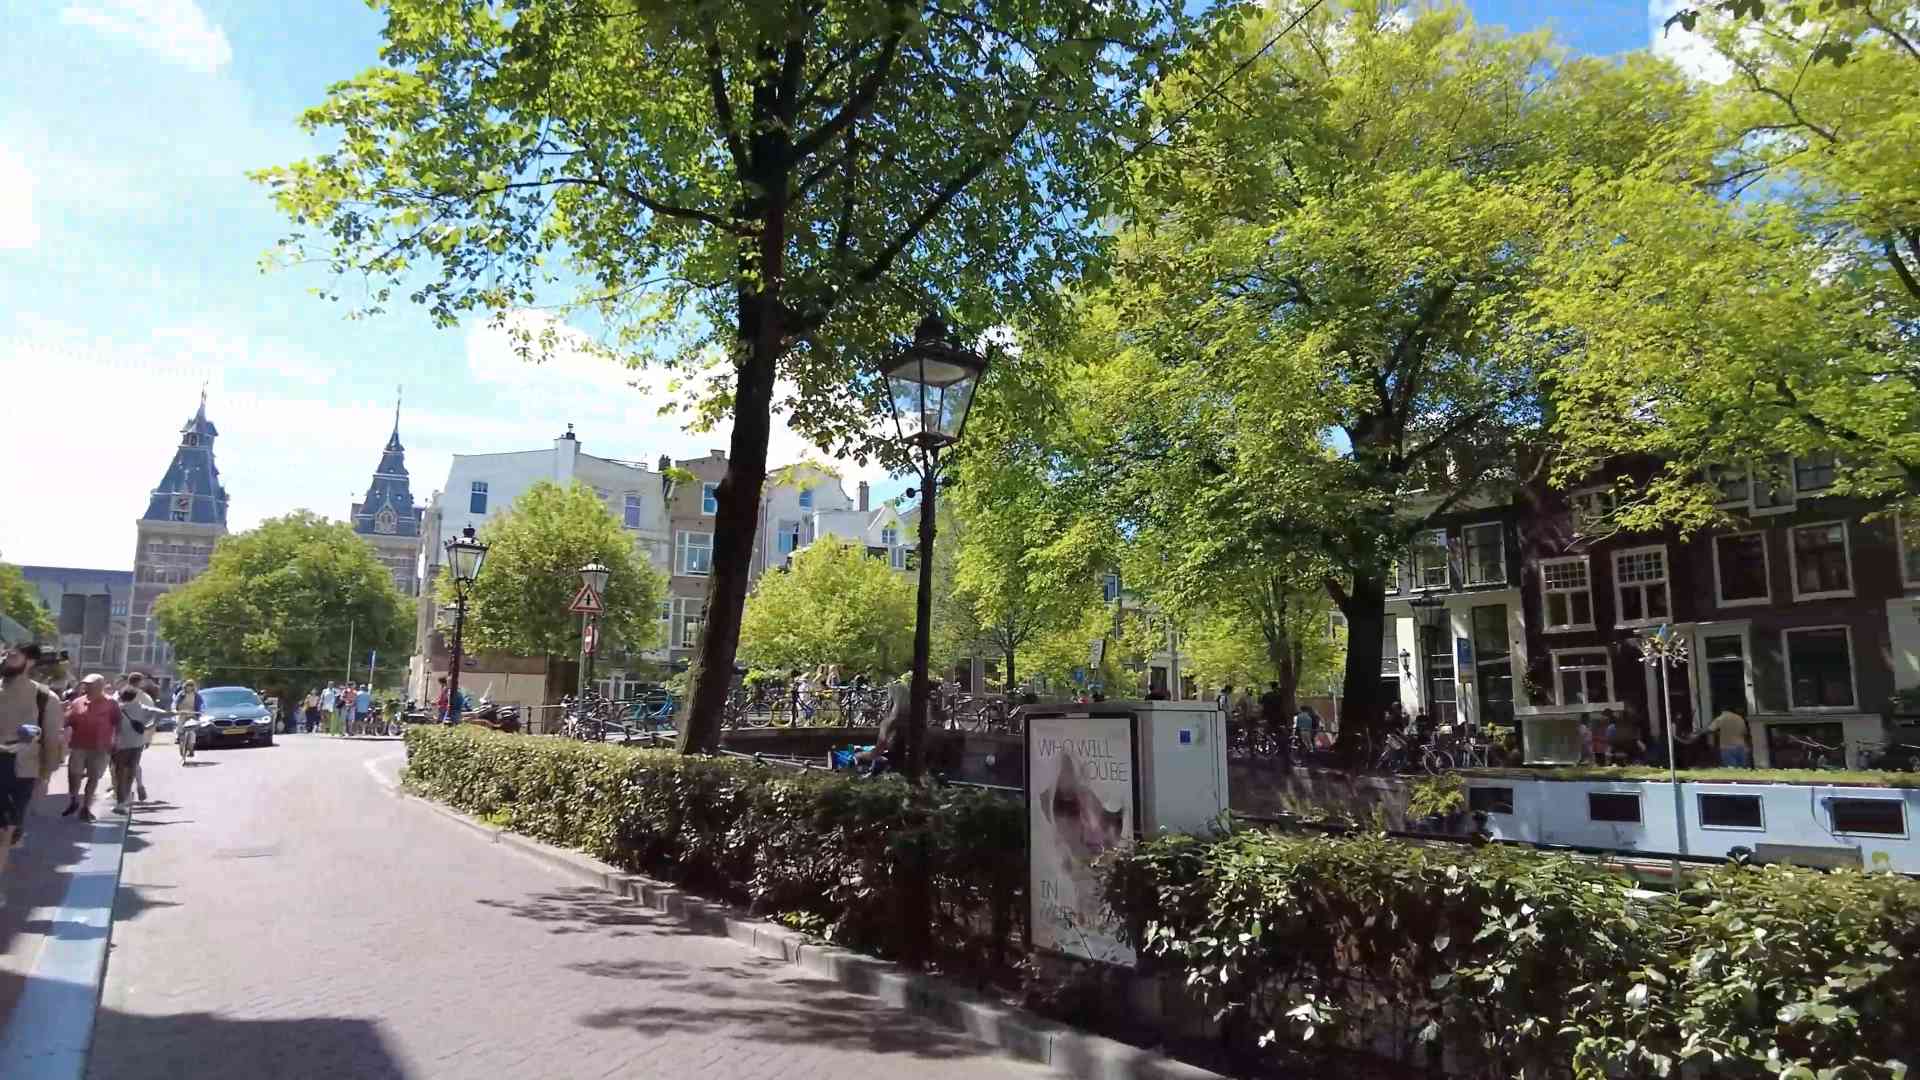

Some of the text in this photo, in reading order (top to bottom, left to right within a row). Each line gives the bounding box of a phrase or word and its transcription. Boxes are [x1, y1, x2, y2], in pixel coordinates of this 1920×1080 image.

[1040, 738, 1112, 759] WHO WILL
[1111, 761, 1129, 782] BE
[1040, 880, 1058, 899] IN
